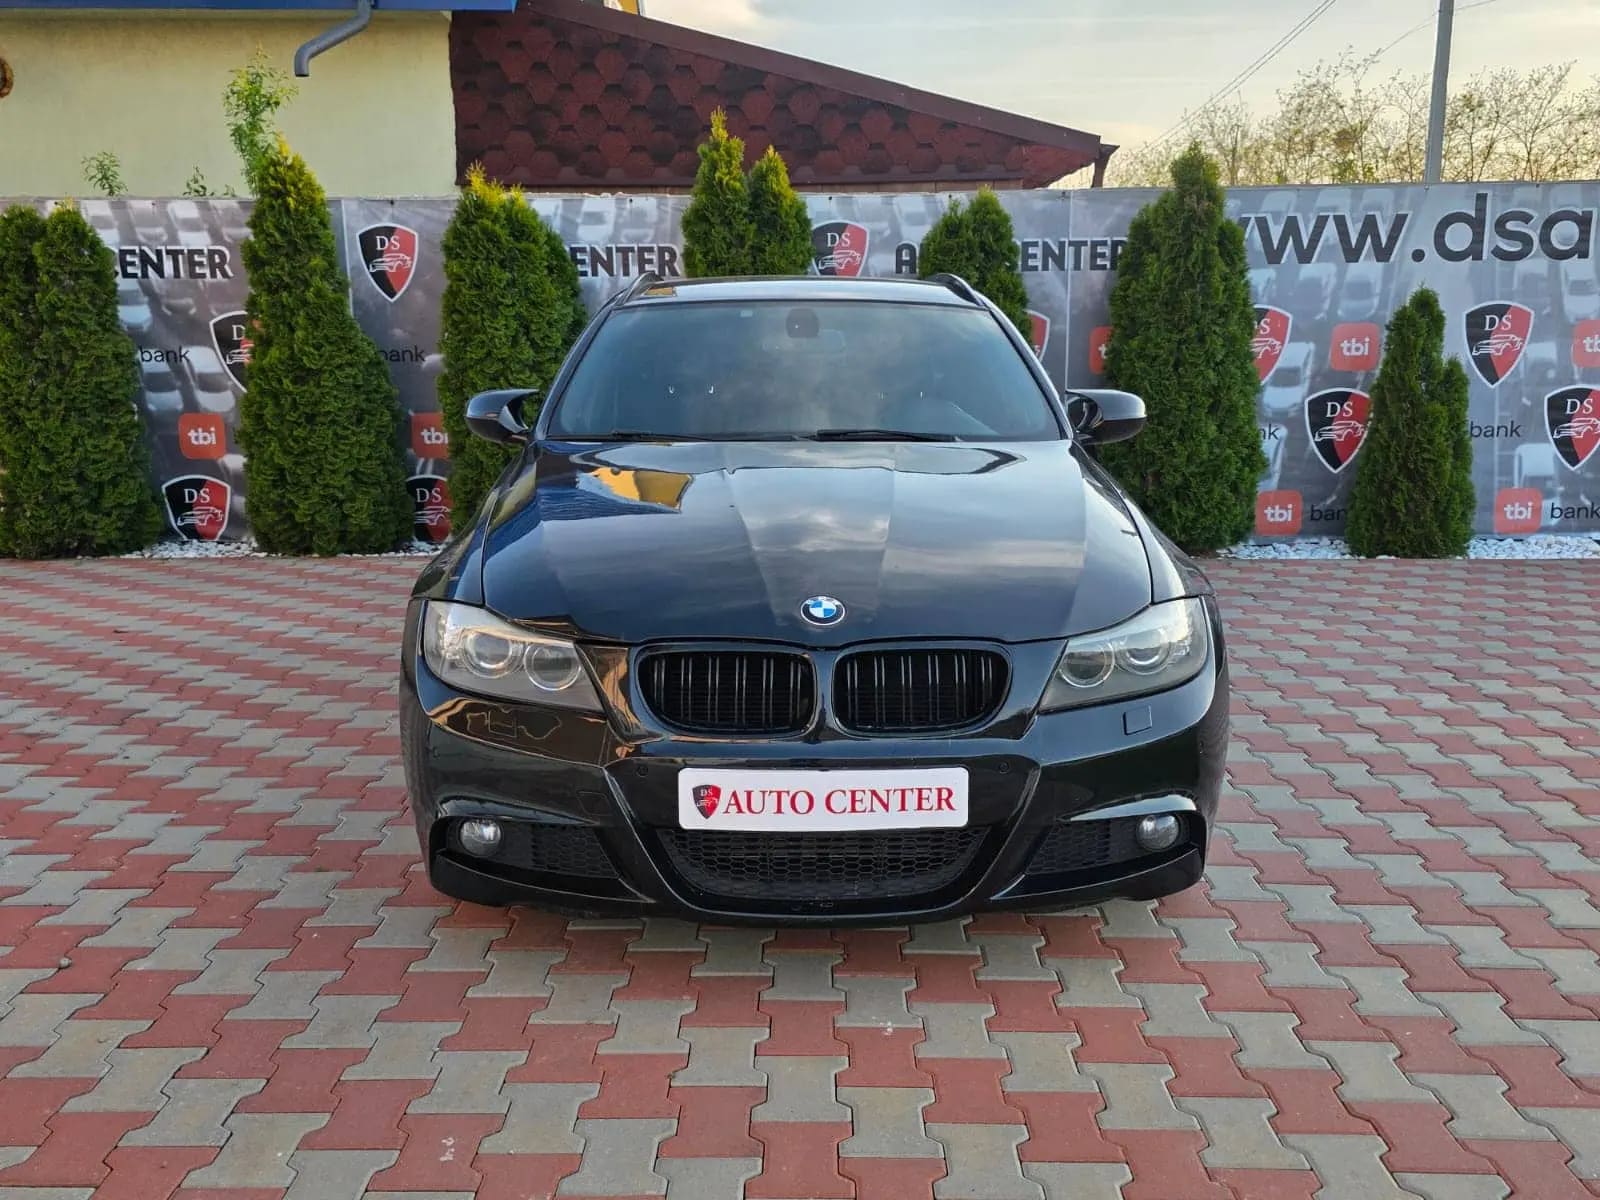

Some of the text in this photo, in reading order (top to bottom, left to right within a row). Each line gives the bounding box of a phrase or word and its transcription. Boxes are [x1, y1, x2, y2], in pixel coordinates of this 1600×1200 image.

[1238, 193, 1593, 265] ww.dsa
[375, 235, 401, 251] DS
[826, 232, 851, 248] DS
[115, 248, 232, 280] ENTER
[569, 246, 680, 278] ENTER
[1254, 318, 1271, 334] S
[1484, 314, 1513, 331] DS
[140, 344, 190, 363] bank
[1340, 337, 1371, 356] tbi
[1325, 401, 1354, 418] DS
[1565, 398, 1594, 415] DS
[187, 426, 217, 446] tbi
[1470, 420, 1521, 438] bank
[183, 487, 211, 504] DS
[415, 487, 442, 503] DS
[1263, 503, 1346, 522] tbi ban
[1503, 501, 1600, 520] tbi bank
[722, 789, 815, 815] AUTO
[824, 786, 957, 814] CENTER
